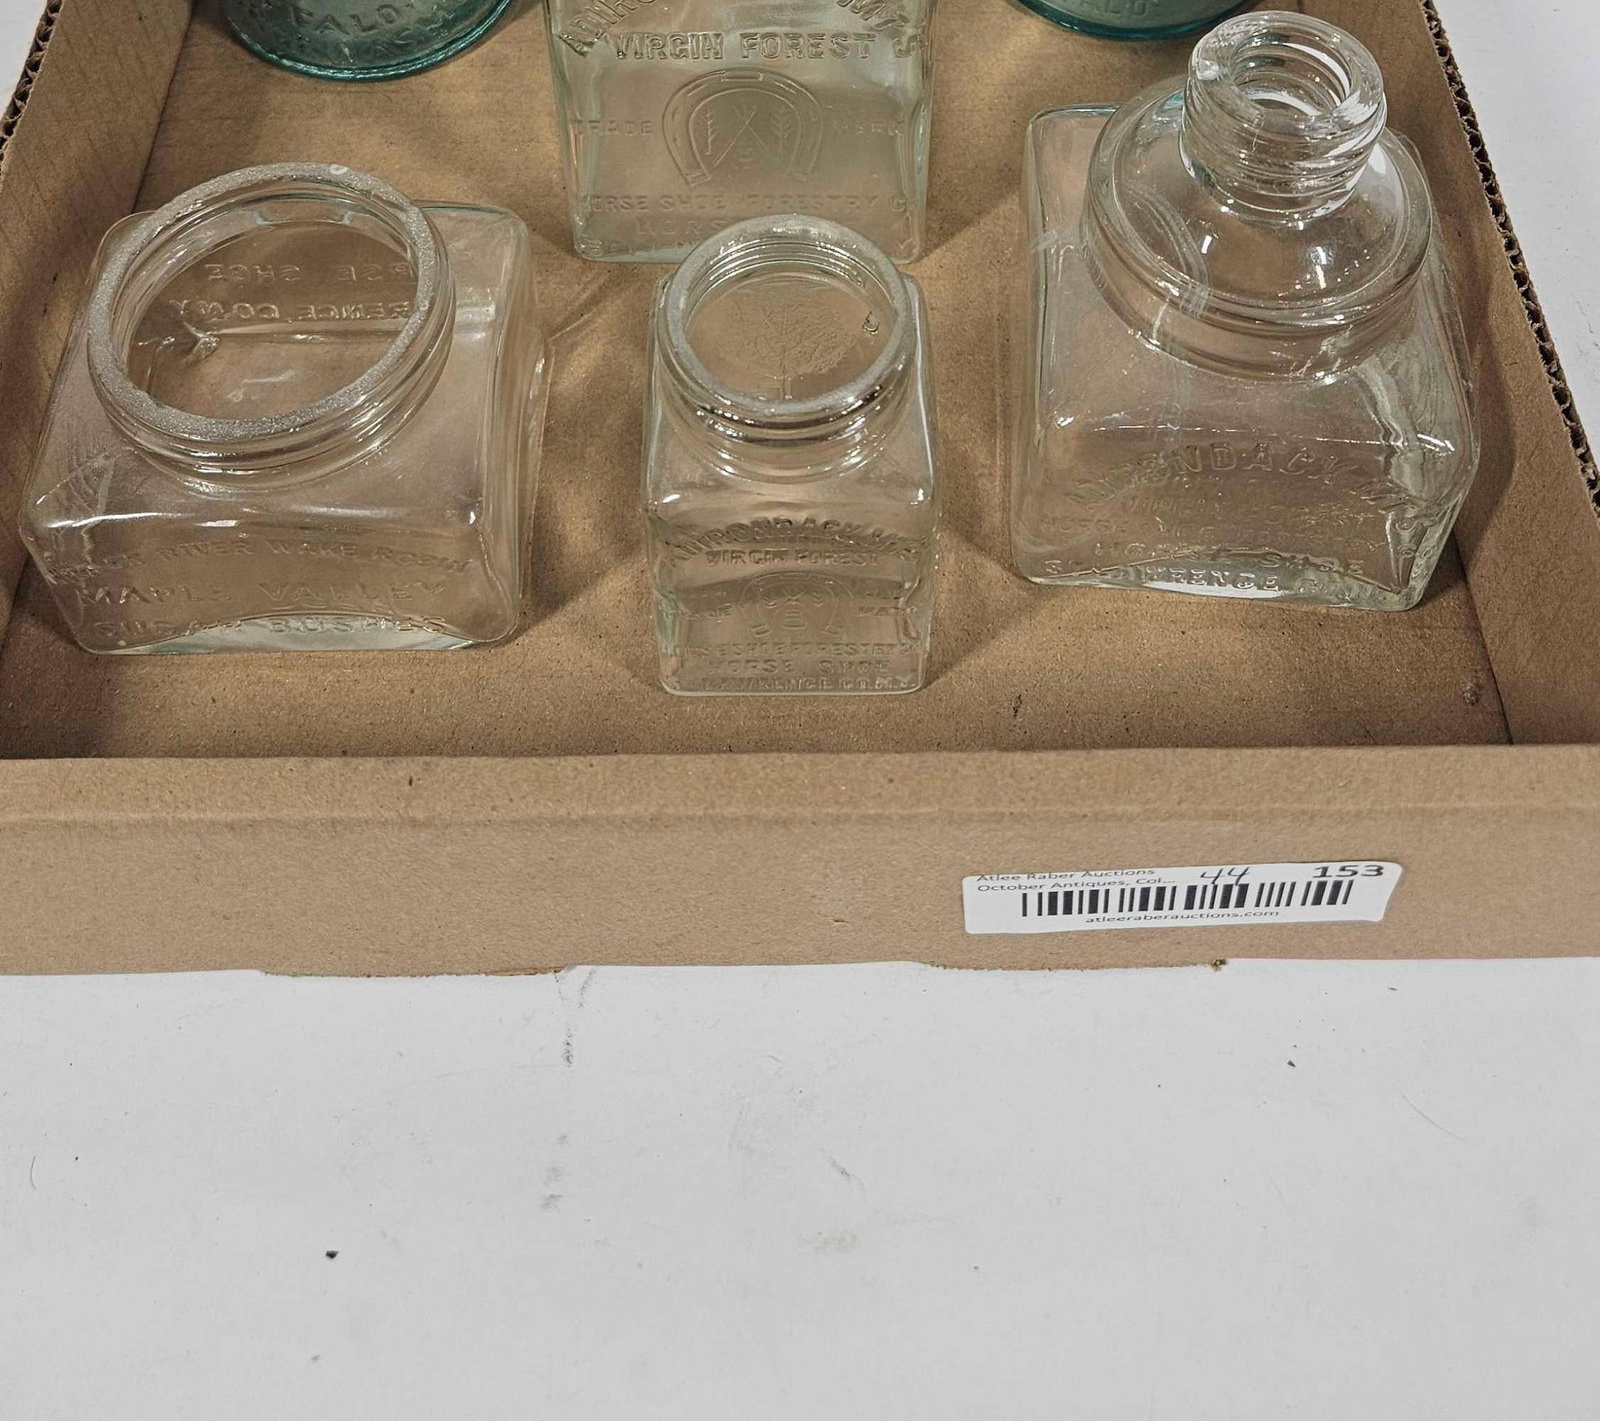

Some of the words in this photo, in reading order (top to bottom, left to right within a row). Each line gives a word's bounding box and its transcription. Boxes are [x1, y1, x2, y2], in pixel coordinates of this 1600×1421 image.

[614, 31, 727, 61] VIRGIN
[739, 32, 876, 61] FOREST
[573, 119, 655, 136] TRADE
[659, 194, 727, 213] SHOE
[741, 193, 880, 212] FORESTRY
[635, 217, 732, 236] HORS
[264, 540, 358, 557] WAKE
[705, 549, 788, 566] VIRGIN
[793, 549, 879, 566] FOREST
[255, 580, 446, 604] VALLEY
[269, 614, 446, 633] BUSHES
[977, 873, 1022, 883] Atlee
[1026, 871, 1076, 881] Raber
[1080, 868, 1156, 879] Auctions
[1312, 863, 1386, 879] 153
[977, 882, 1046, 893] October
[1050, 879, 1131, 892] Antiques,
[1085, 909, 1280, 924] atleeraberauctions.com
